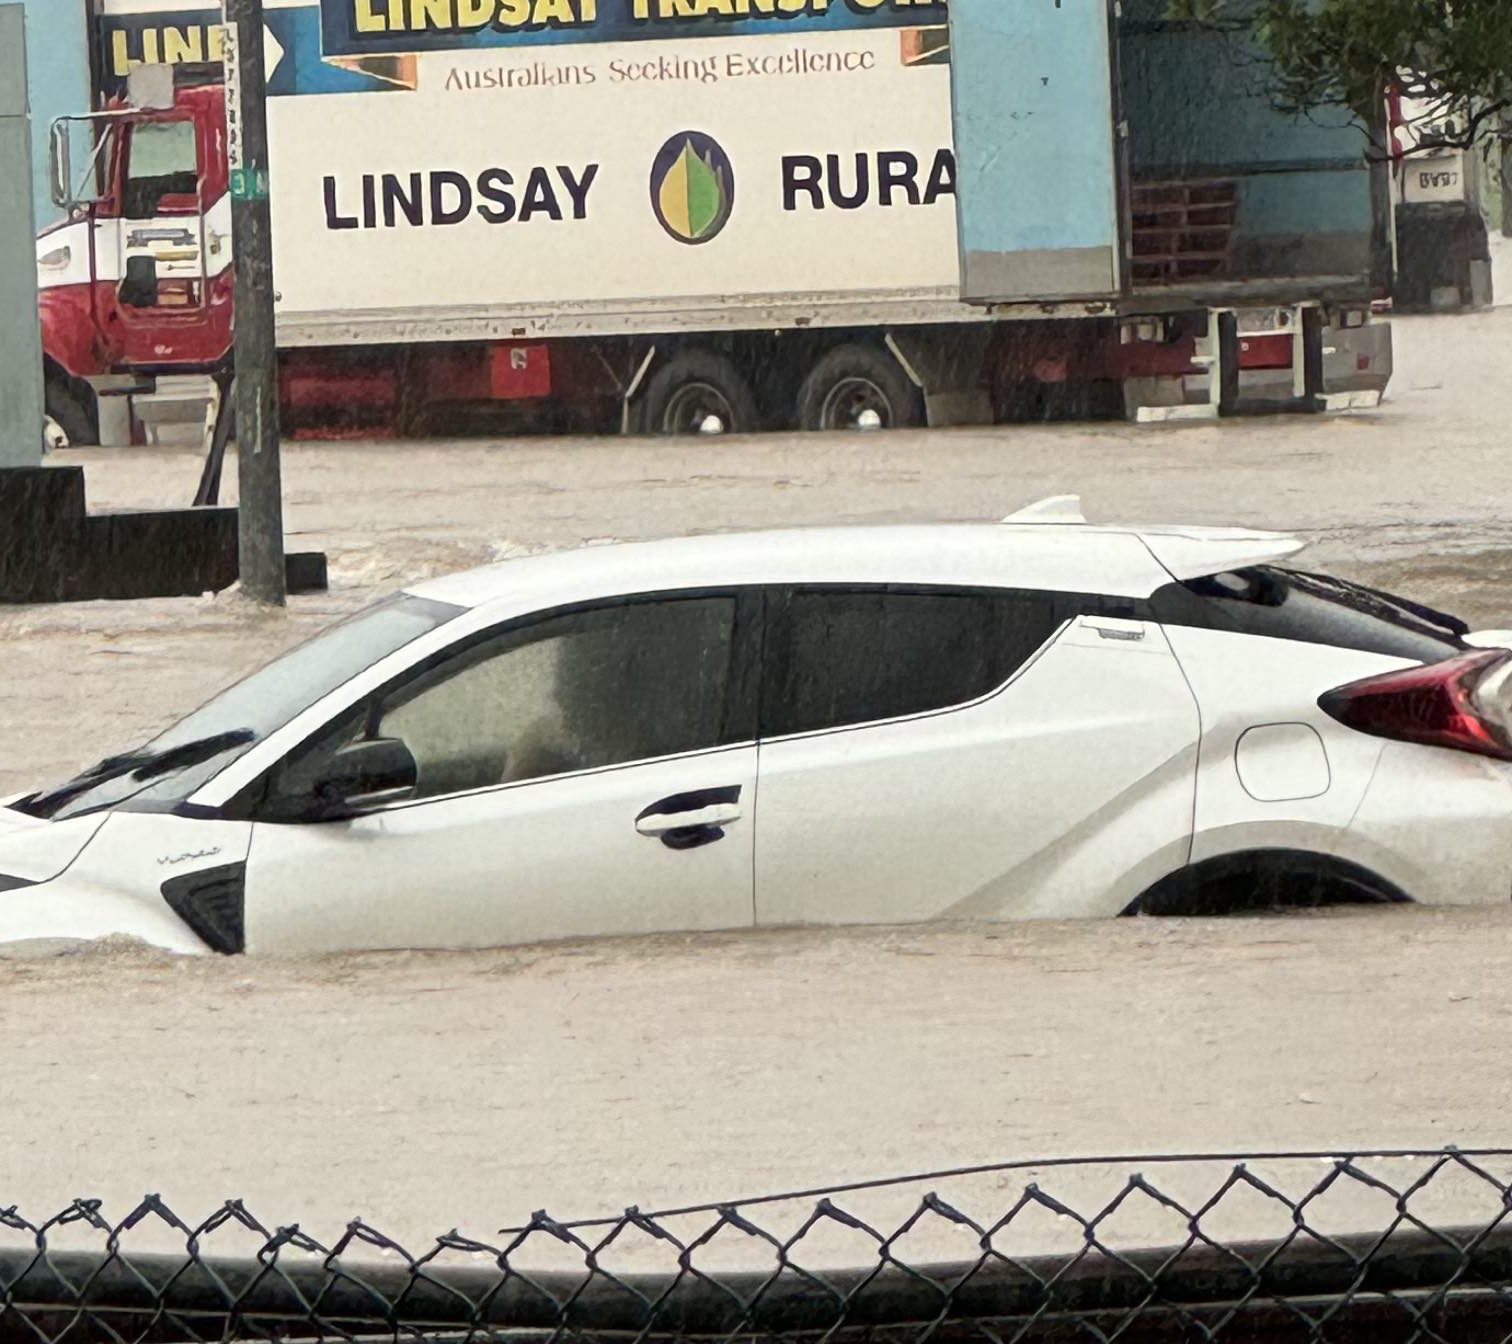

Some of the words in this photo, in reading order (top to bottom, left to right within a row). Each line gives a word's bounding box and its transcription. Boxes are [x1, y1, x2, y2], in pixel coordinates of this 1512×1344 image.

[445, 62, 596, 90] Australians
[609, 56, 718, 83] Seeking
[726, 49, 875, 77] Excellence
[324, 164, 599, 230] LINDSAY
[781, 148, 958, 211] RURA
